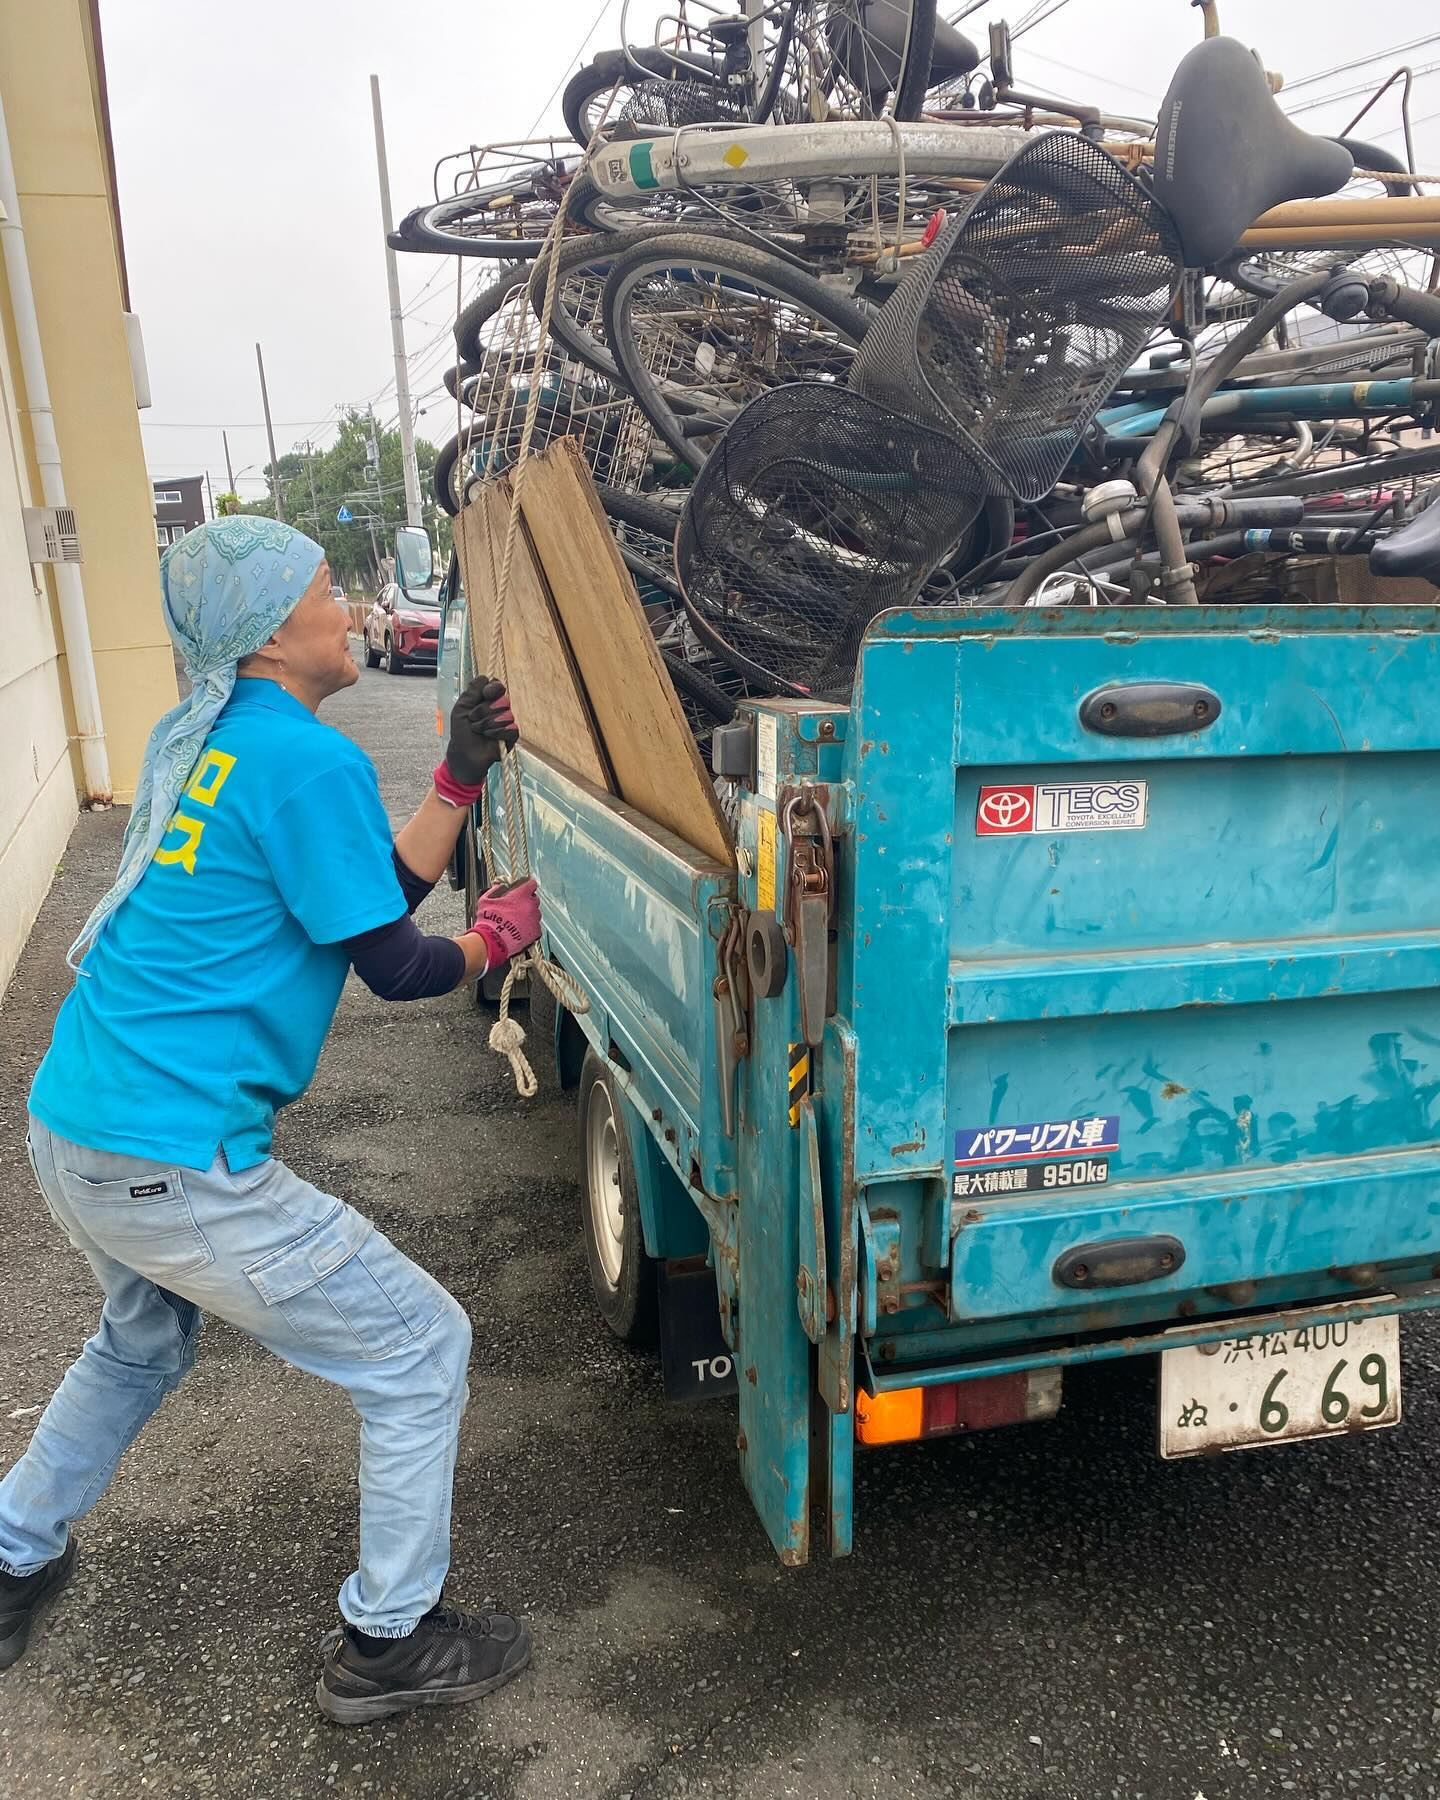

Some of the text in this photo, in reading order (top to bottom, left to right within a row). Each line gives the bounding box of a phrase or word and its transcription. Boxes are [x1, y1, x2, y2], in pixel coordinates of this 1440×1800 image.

[1042, 785, 1140, 827] TECS
[1098, 812, 1136, 820] EXCELLENT
[1066, 818, 1136, 828] CONVERSION SERIES
[483, 910, 503, 924] Lite
[968, 1117, 1108, 1157] パワーリフト車
[953, 1160, 1108, 1196] 最大積載量 950kg
[691, 1354, 735, 1382] TO
[1177, 1397, 1209, 1428] ぬ
